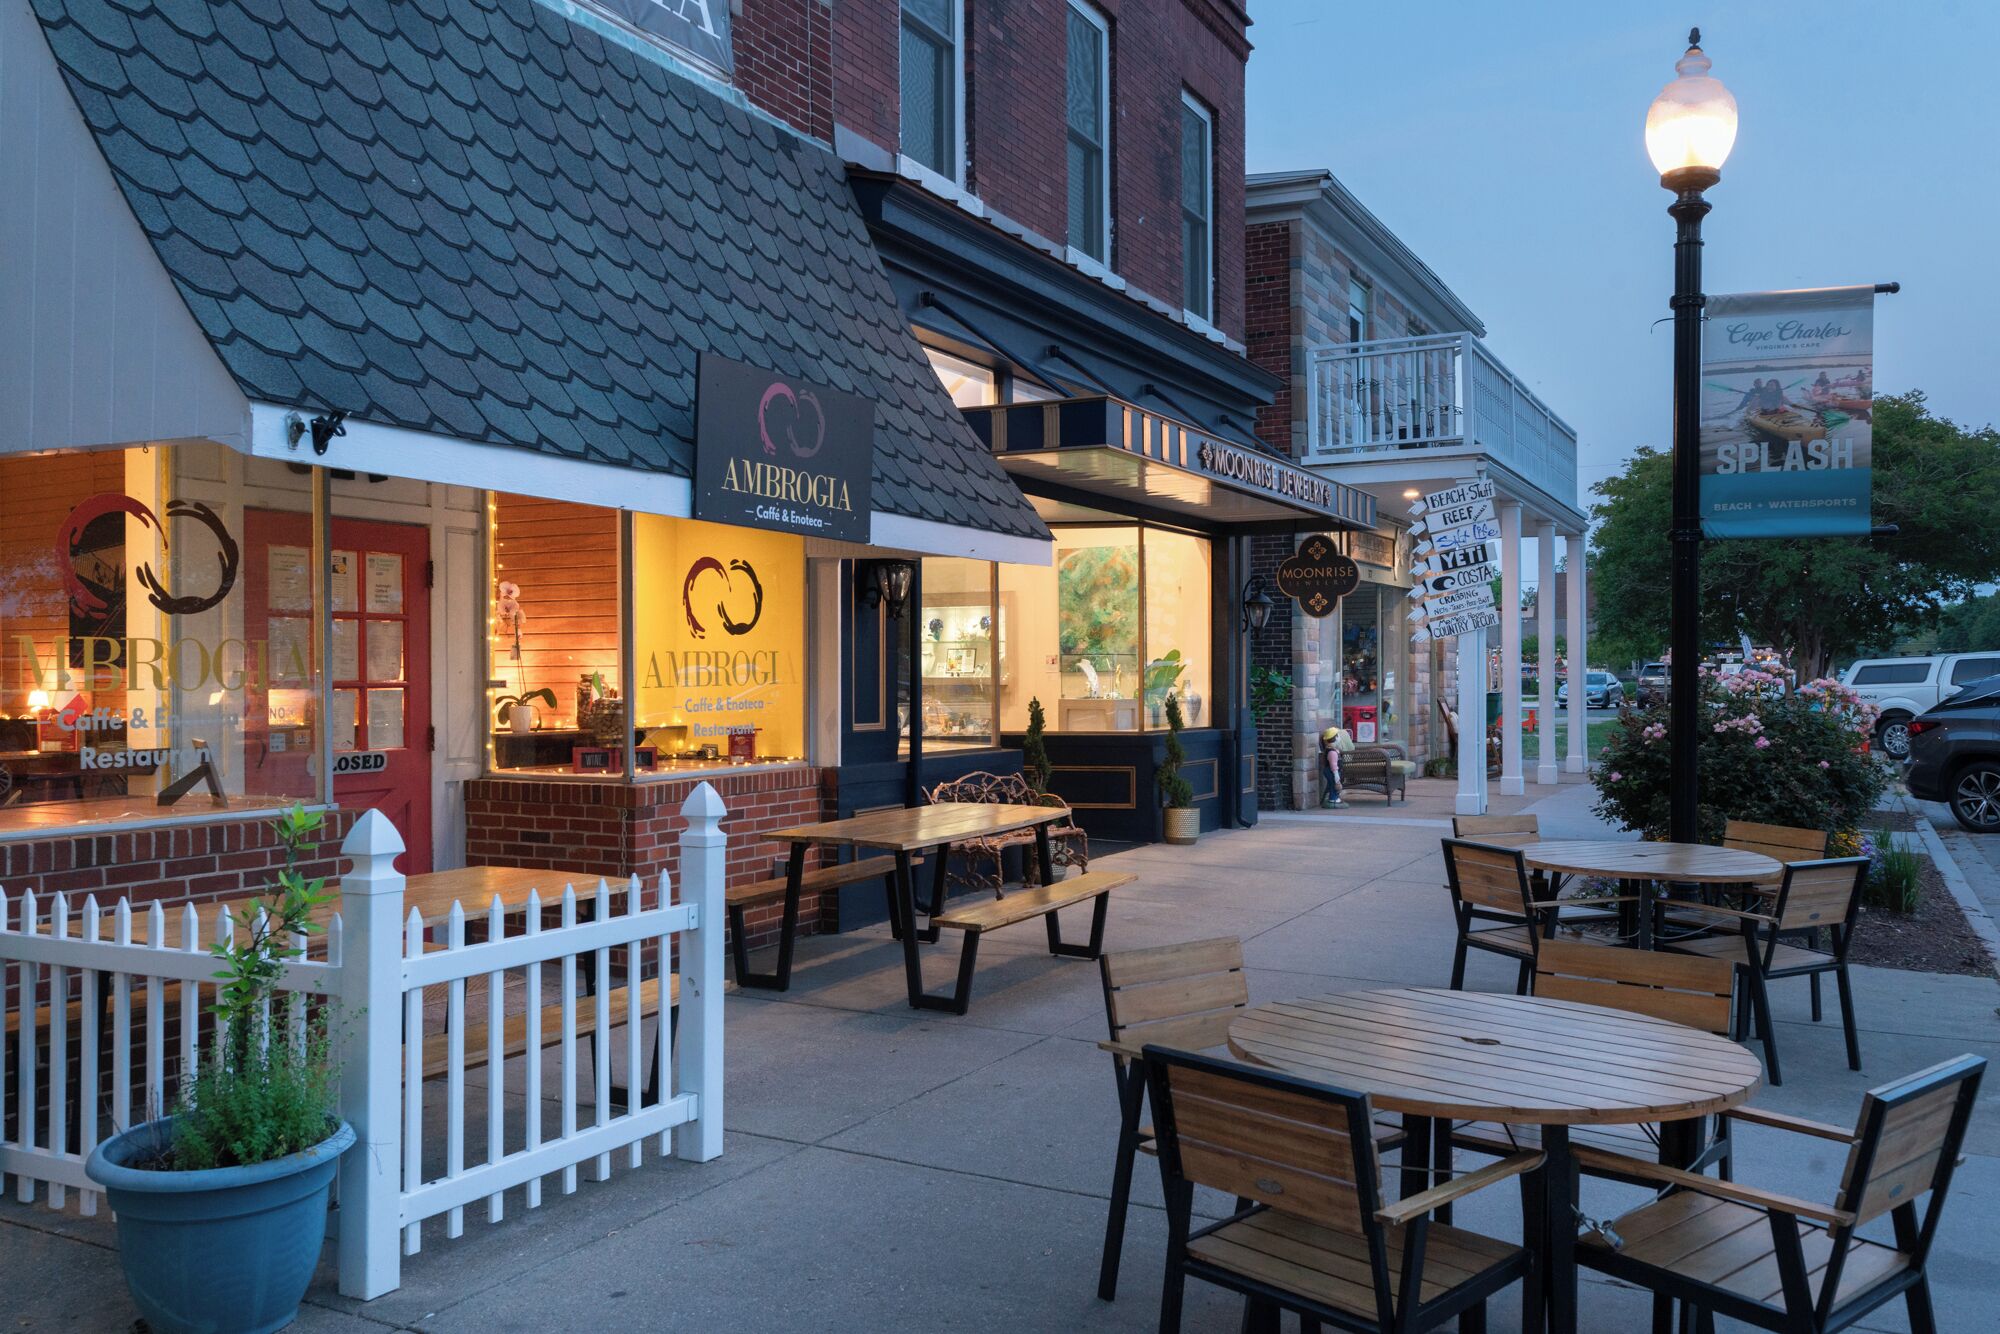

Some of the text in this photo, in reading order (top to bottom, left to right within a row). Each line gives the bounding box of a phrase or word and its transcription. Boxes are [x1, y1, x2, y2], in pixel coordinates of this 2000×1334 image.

[1726, 320, 1852, 347] Cape Charles
[1756, 343, 1797, 351] VIRGINIA'S
[1716, 438, 1854, 475] SPLASH
[721, 457, 853, 512] AMBROGIA
[1215, 446, 1325, 504] MOONRISE JEWELRY
[1430, 488, 1466, 508] BEACH
[1713, 502, 1752, 511] BEACH
[1768, 498, 1857, 509] WATERSPORTS
[756, 505, 822, 528] Caffé & Enoteca
[1442, 506, 1473, 525] REEF
[1282, 567, 1354, 578] MOONRISE
[1457, 564, 1493, 586] COSTA
[1439, 589, 1479, 605] CRABBING
[1434, 614, 1496, 638] COUNTRY DECOR
[2, 634, 313, 692] MBROGIA
[685, 696, 764, 712] Caffé & Enoteca
[57, 706, 123, 731] Caffé
[129, 707, 149, 729] &
[694, 722, 755, 737] Restaurant
